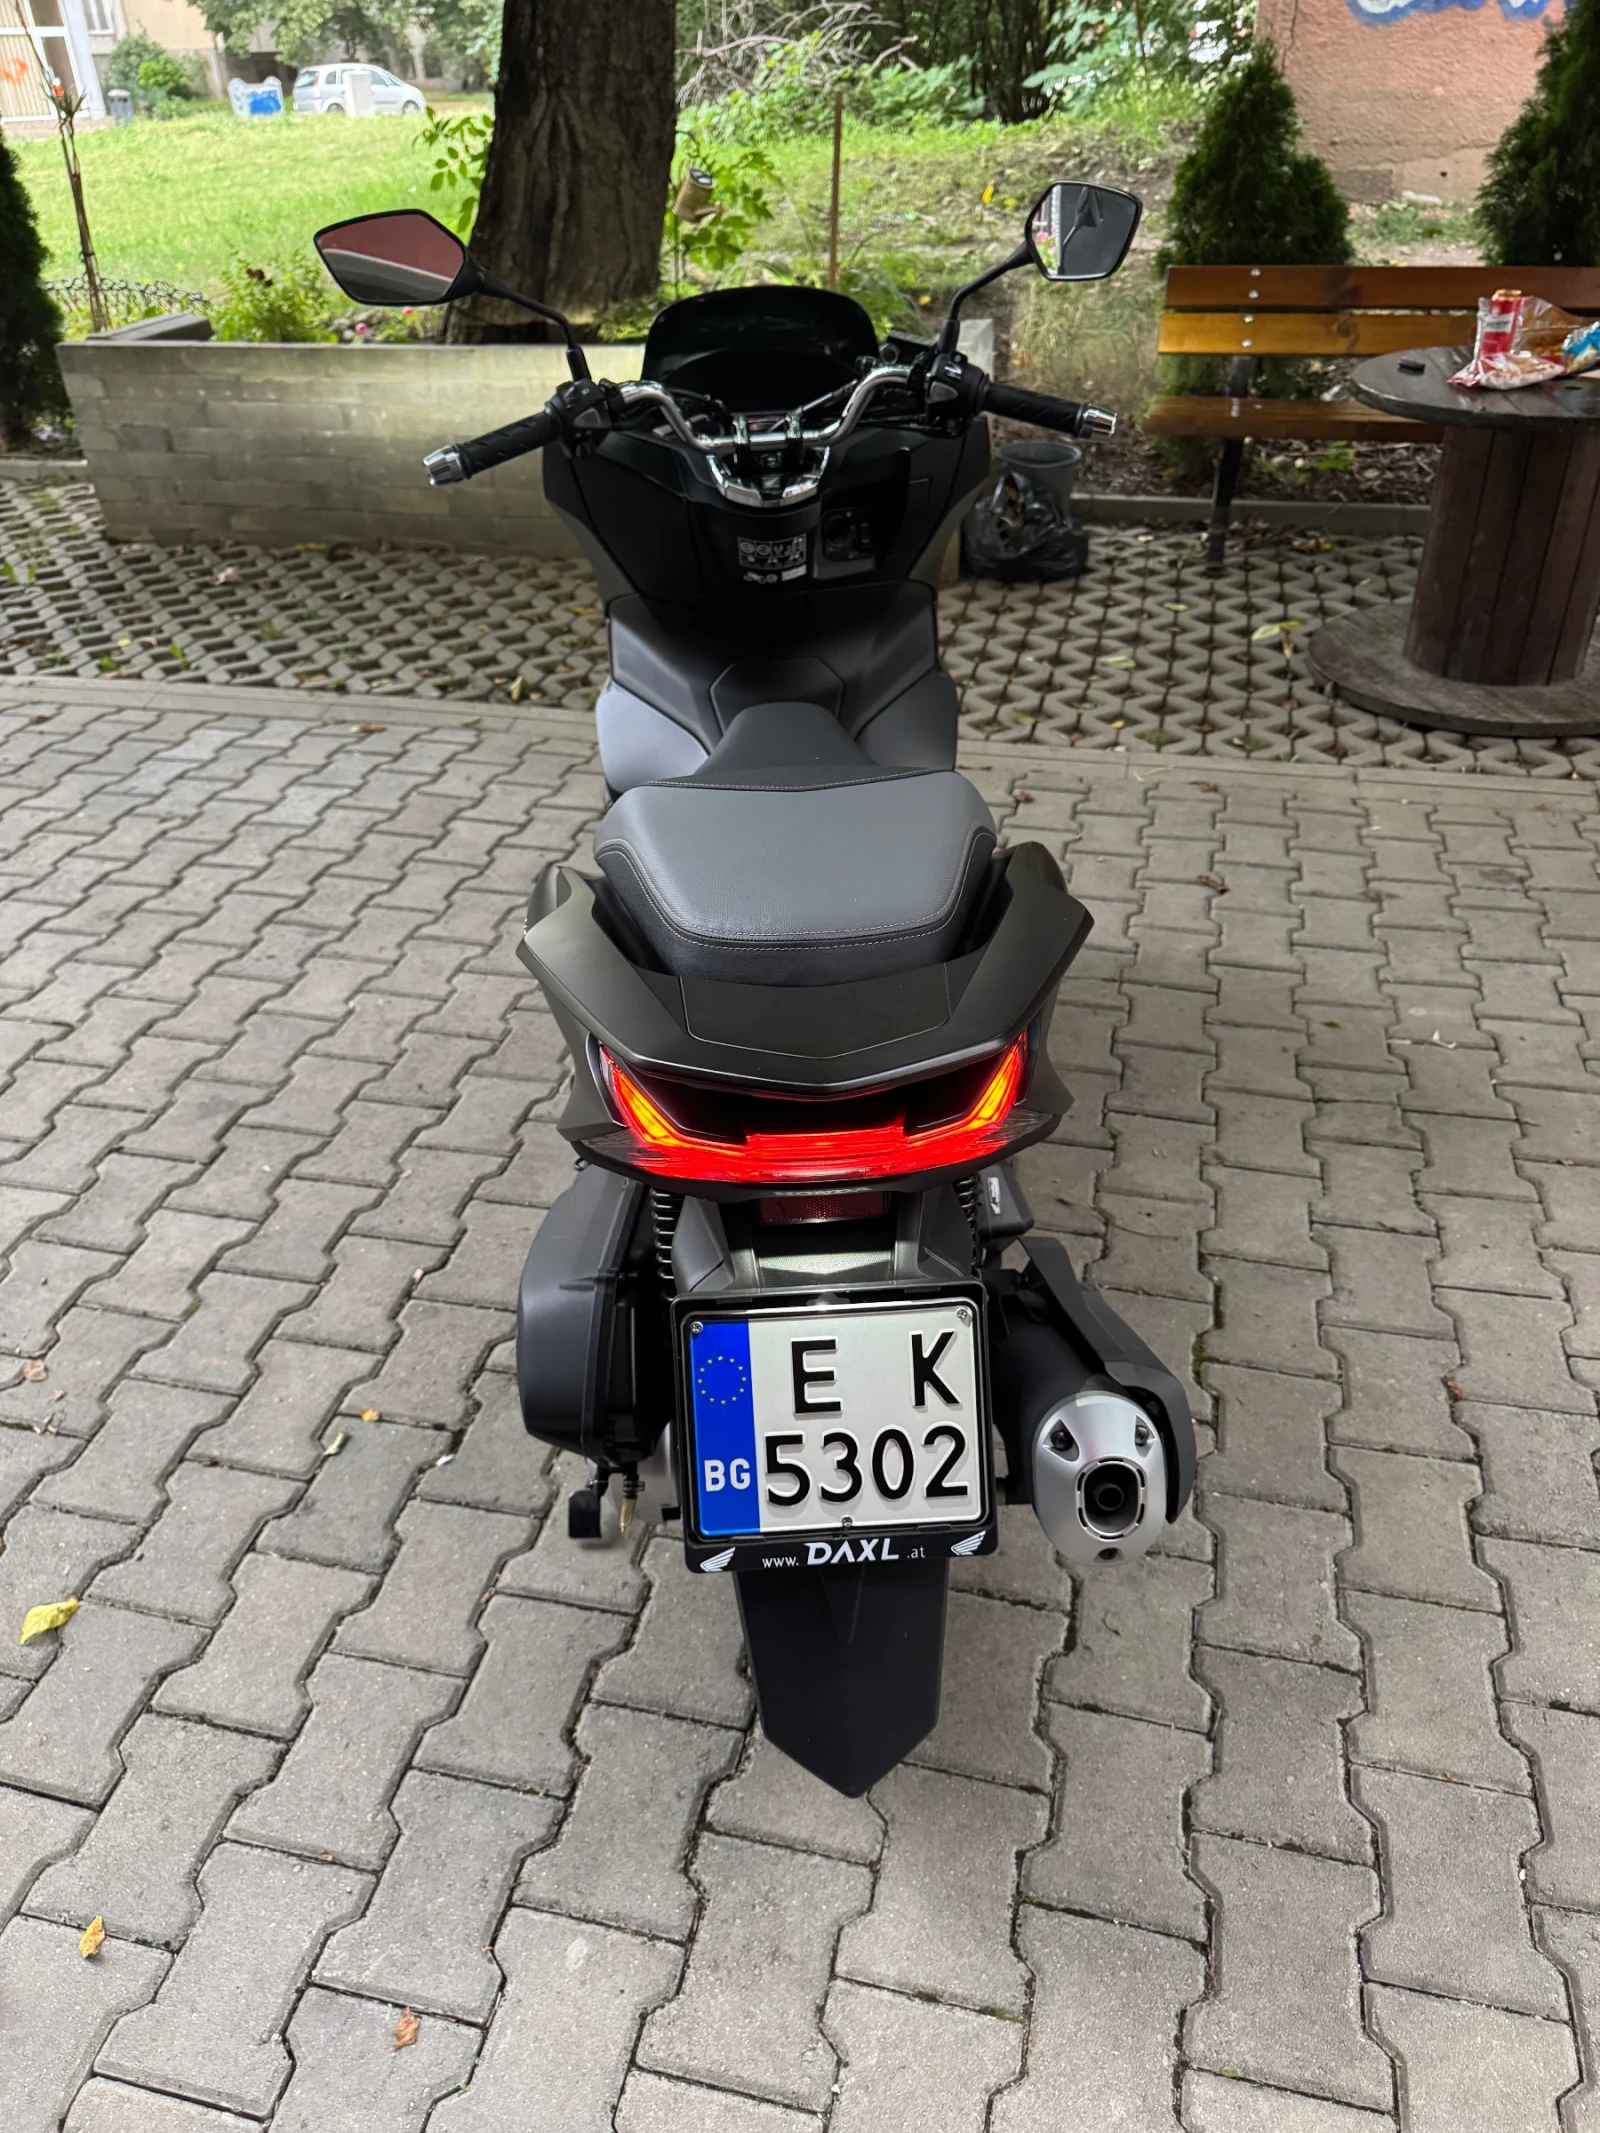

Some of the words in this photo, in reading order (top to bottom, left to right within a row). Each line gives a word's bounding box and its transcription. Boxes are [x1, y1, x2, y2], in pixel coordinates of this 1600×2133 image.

[790, 1338, 842, 1414] E
[910, 1331, 961, 1408] K
[704, 1458, 751, 1492] BG
[764, 1425, 969, 1507] 5302
[762, 1556, 799, 1568] www.
[906, 1546, 925, 1559] .at
